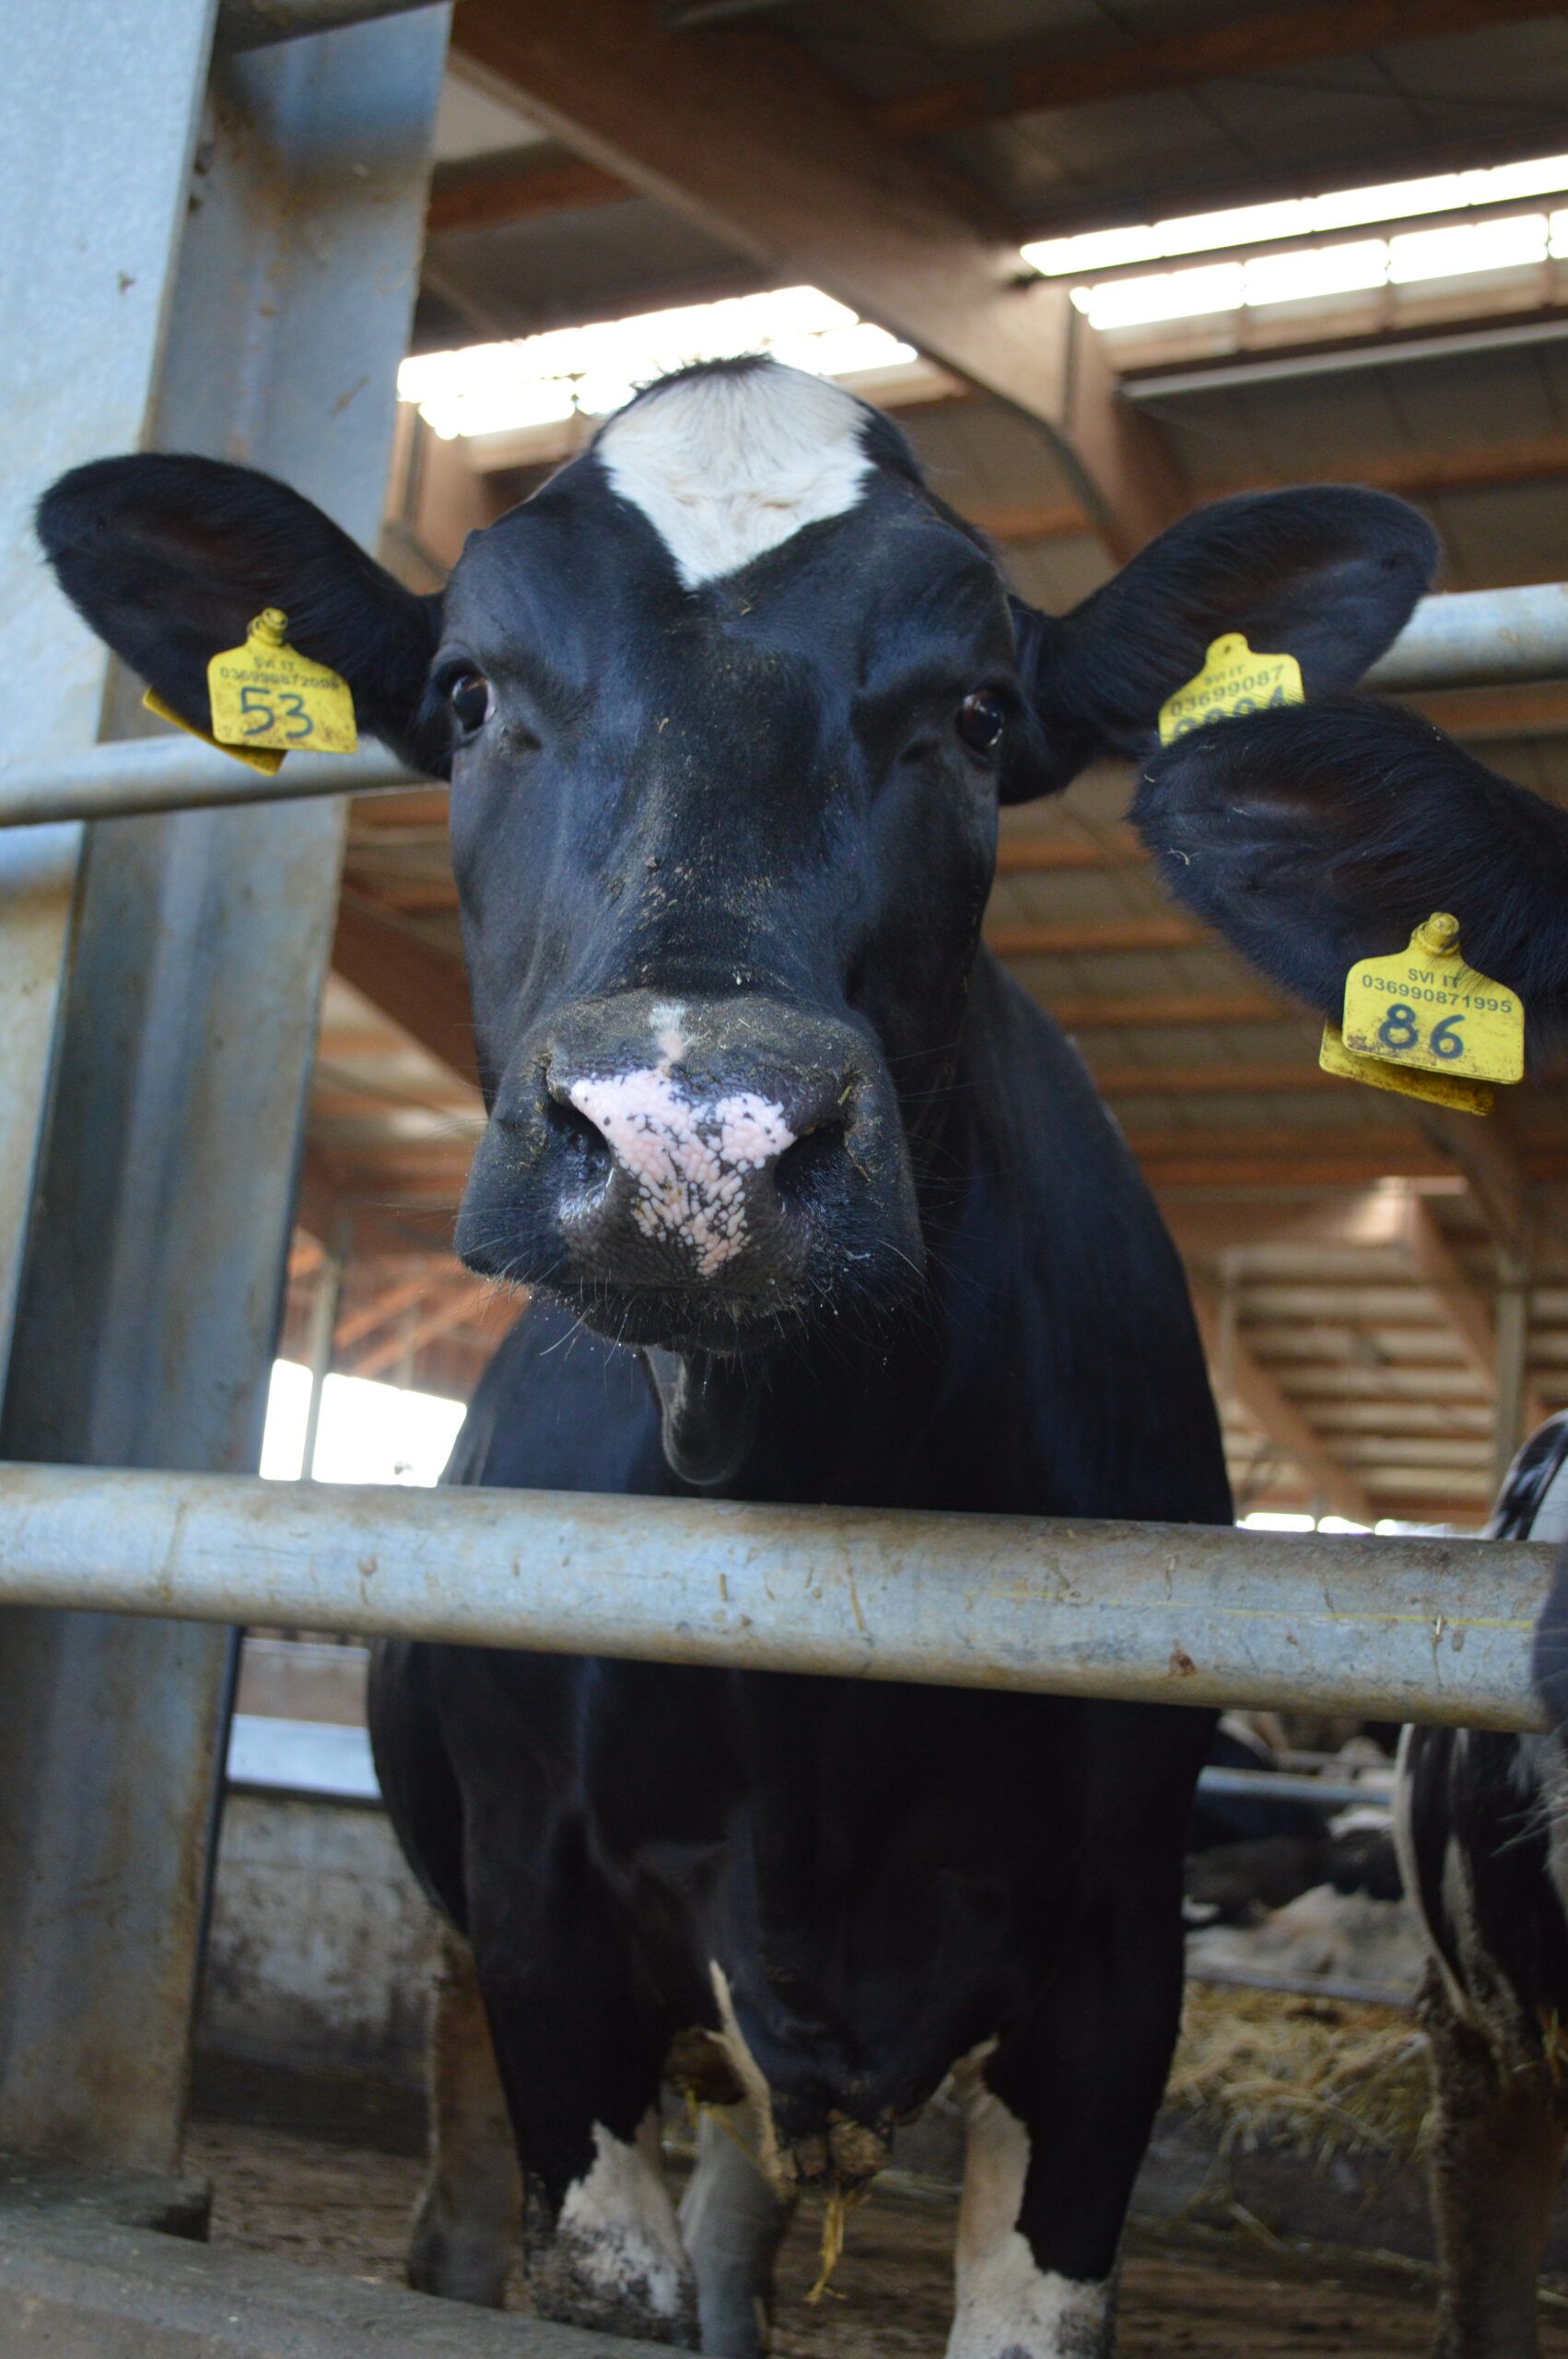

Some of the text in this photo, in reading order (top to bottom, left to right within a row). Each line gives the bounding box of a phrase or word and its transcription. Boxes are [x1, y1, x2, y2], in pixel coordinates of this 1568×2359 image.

[240, 686, 314, 738] 53
[1362, 974, 1513, 1014] 036990871995
[1408, 968, 1462, 989] SVI IT
[1378, 1003, 1466, 1059] 86
